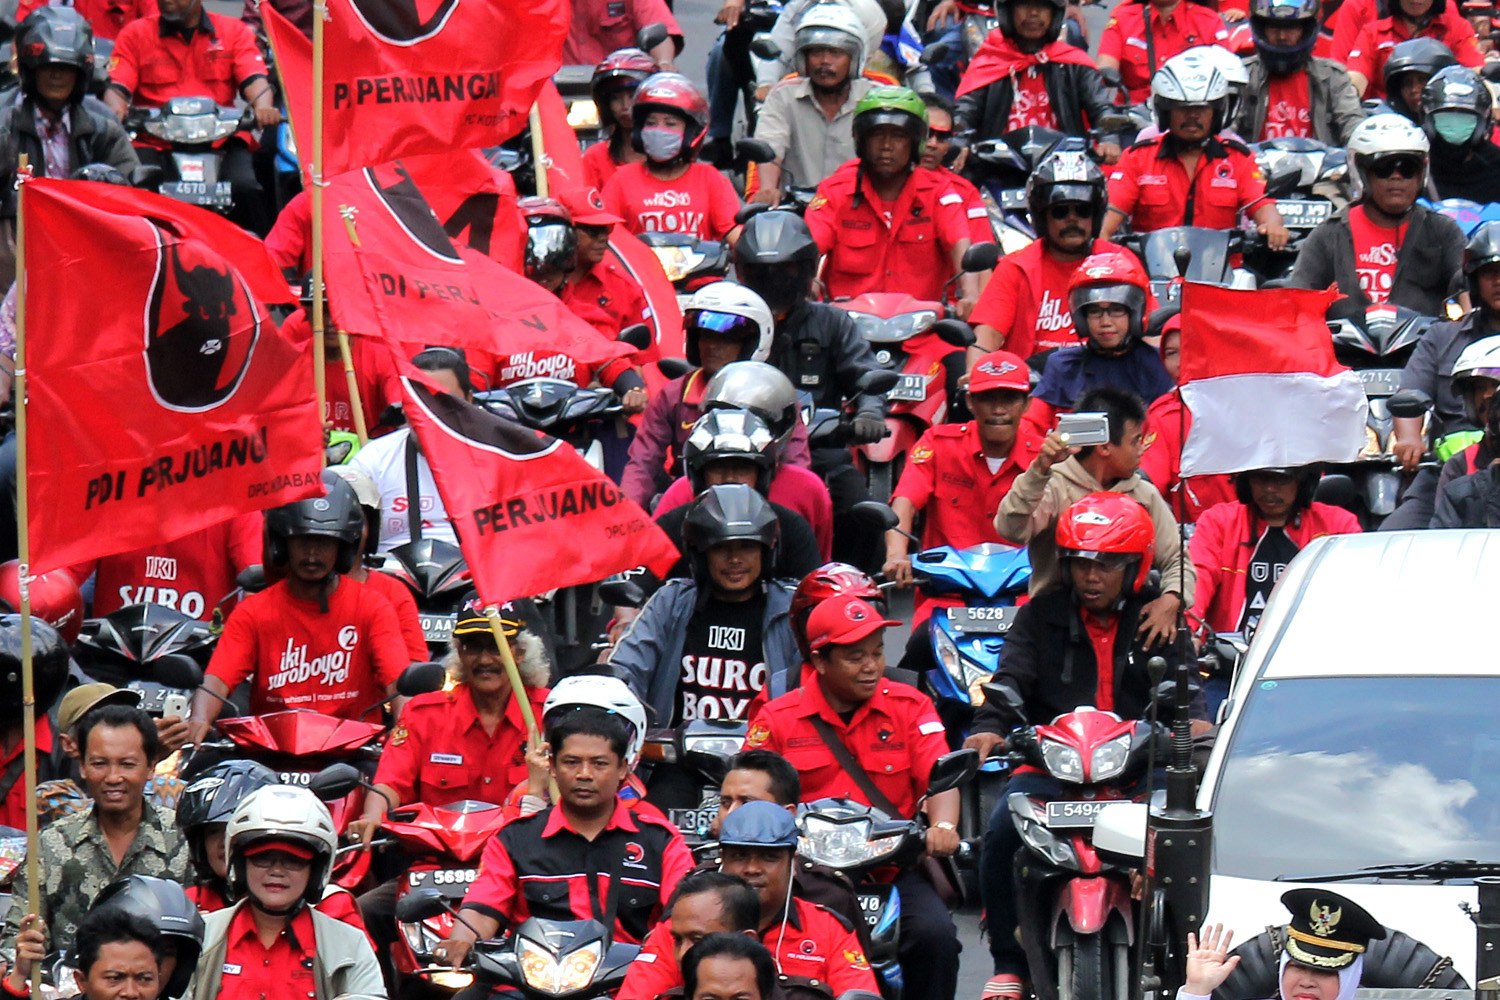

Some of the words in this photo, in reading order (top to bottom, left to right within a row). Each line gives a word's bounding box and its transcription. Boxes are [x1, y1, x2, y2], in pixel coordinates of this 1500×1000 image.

[145, 556, 178, 581] IKI
[948, 608, 958, 620] L
[968, 607, 1004, 620] 5628
[709, 626, 746, 651] IKI
[1051, 804, 1060, 818] L
[1064, 803, 1101, 817] 5494
[410, 873, 421, 887] L
[435, 869, 477, 890] 5698
